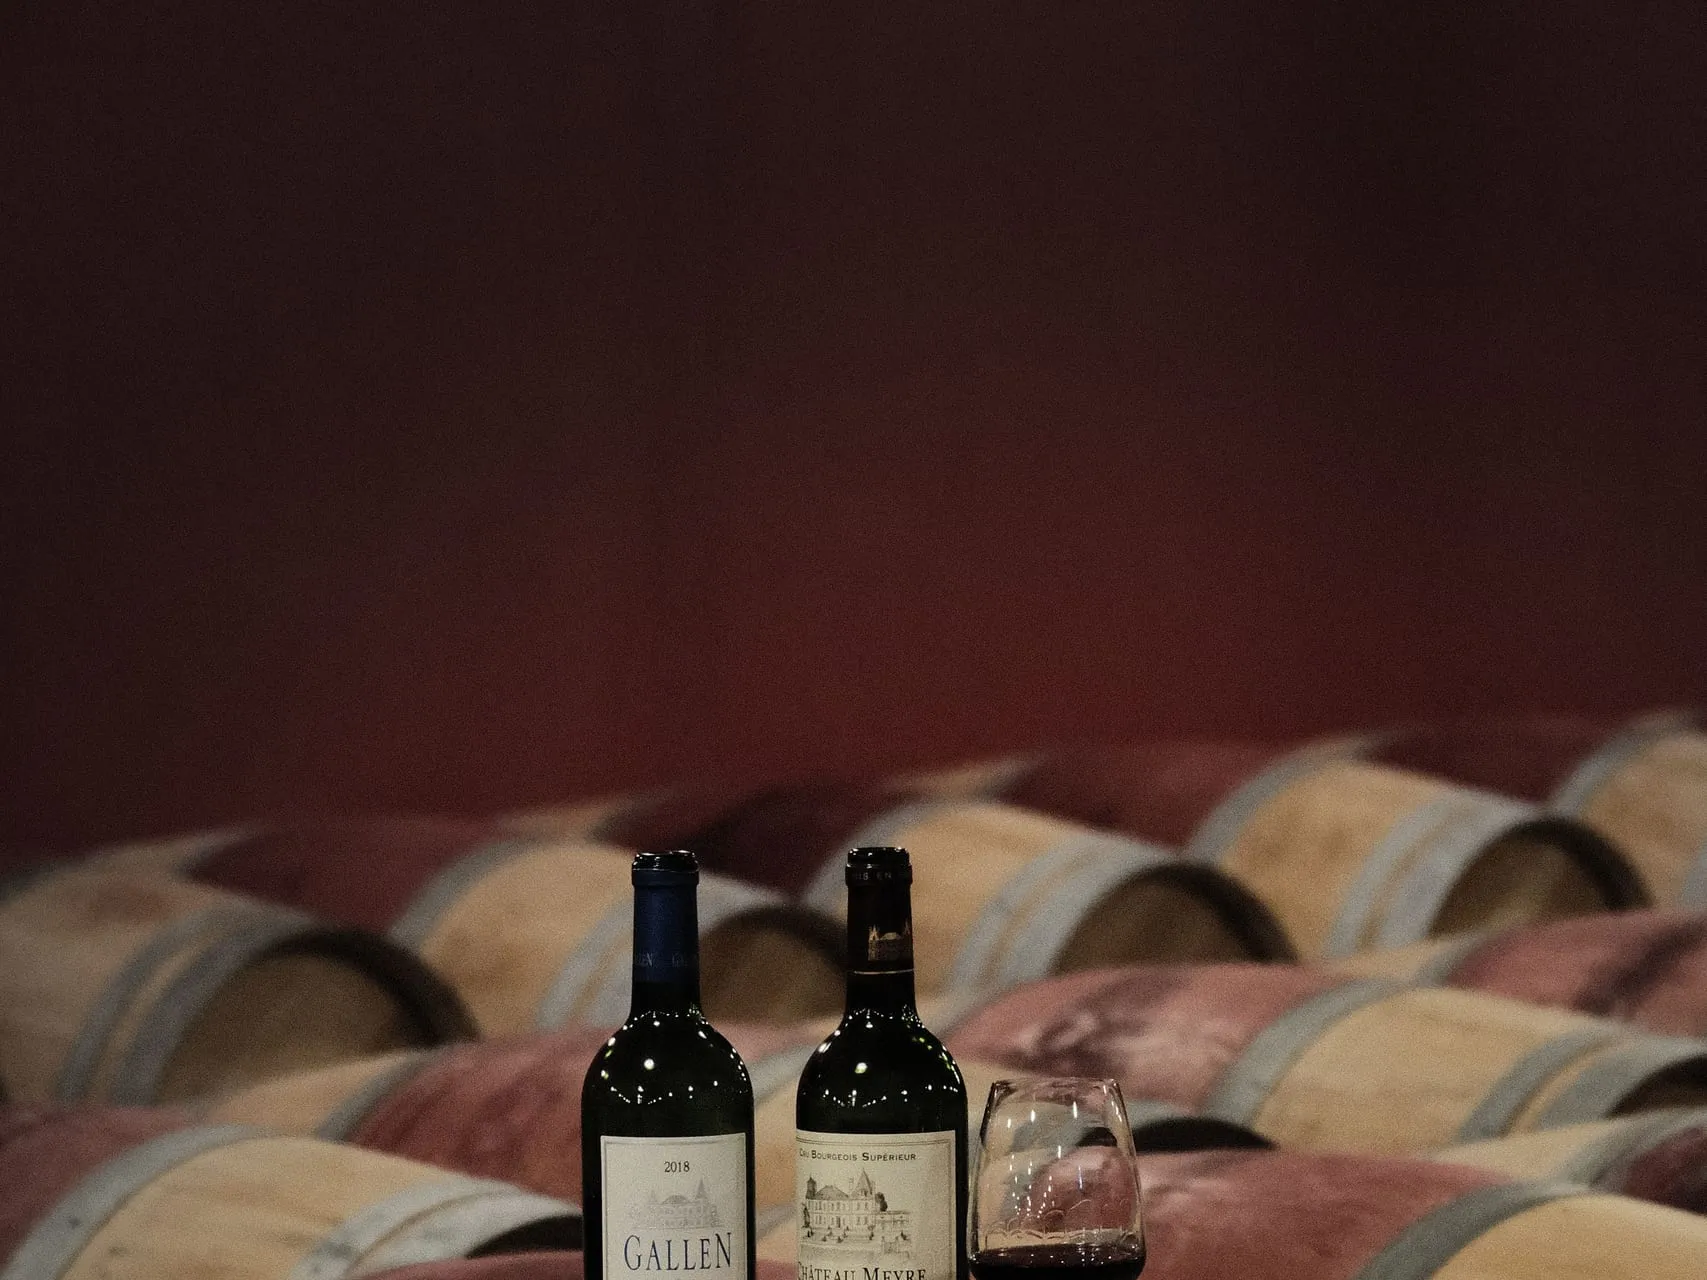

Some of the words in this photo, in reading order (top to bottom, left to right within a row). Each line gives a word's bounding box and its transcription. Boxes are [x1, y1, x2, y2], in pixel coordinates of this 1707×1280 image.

[811, 1149, 858, 1161] BOURGEOIS
[862, 1151, 917, 1162] SUPÉRIEUR
[664, 1160, 690, 1173] 2018
[623, 1232, 732, 1271] GALLEN
